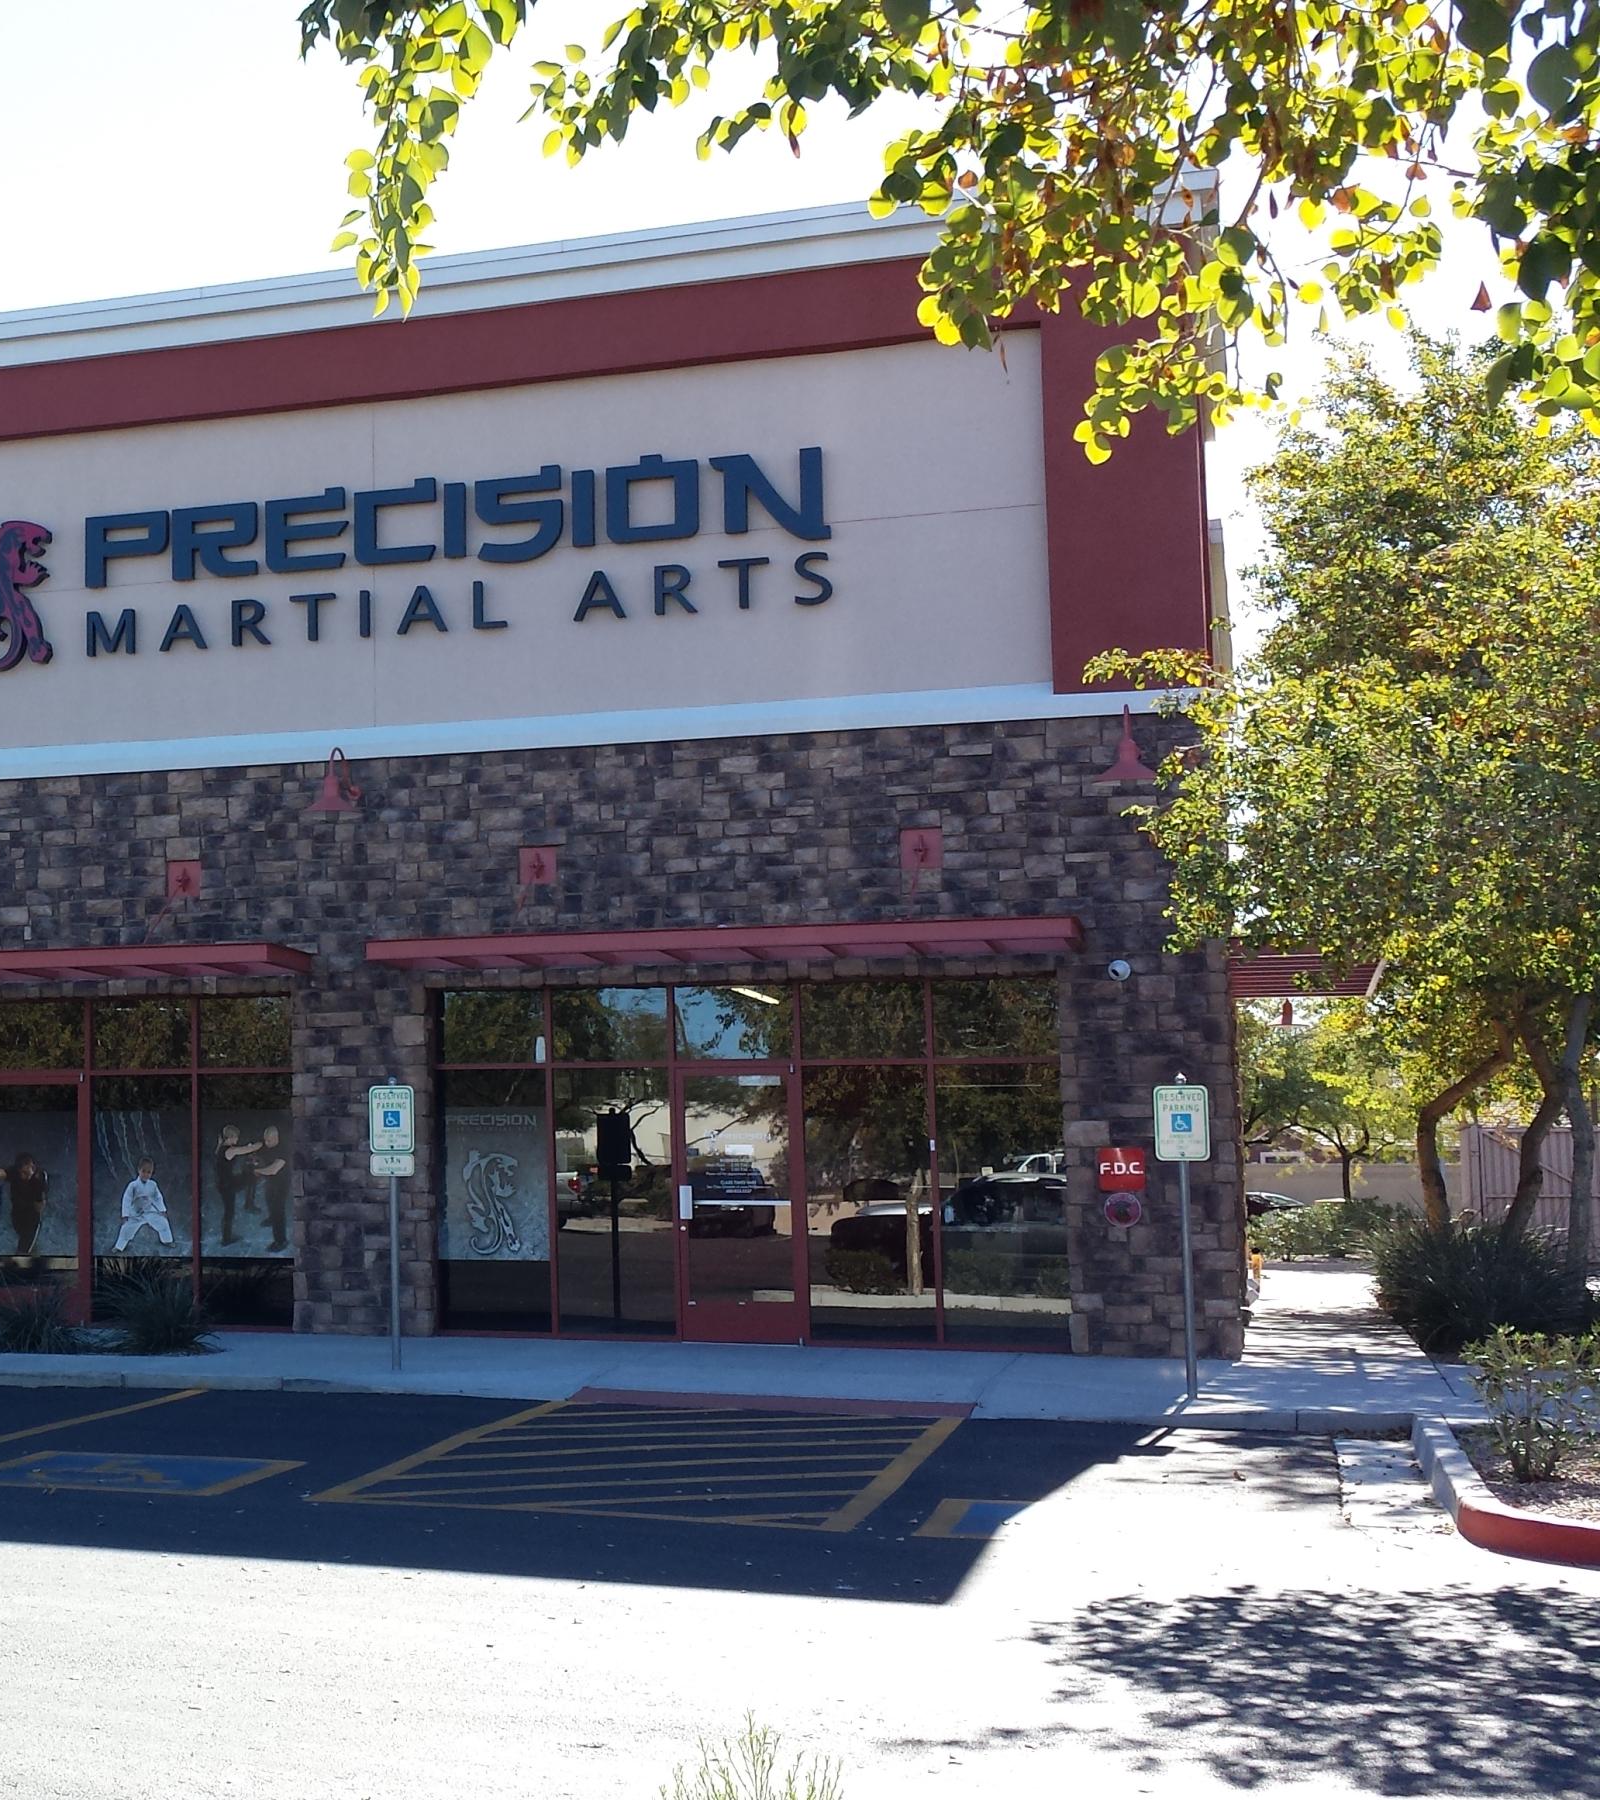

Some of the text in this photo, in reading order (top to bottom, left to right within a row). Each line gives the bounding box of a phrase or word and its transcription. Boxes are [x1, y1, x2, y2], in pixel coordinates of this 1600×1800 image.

[85, 446, 832, 588] PRECISION
[86, 551, 834, 657] MARTIAL ARTS
[1159, 1093, 1203, 1102] RESERVED
[1162, 1104, 1200, 1112] PARKING
[445, 1113, 536, 1127] PRECISION
[1099, 1162, 1144, 1175] F.D.C.
